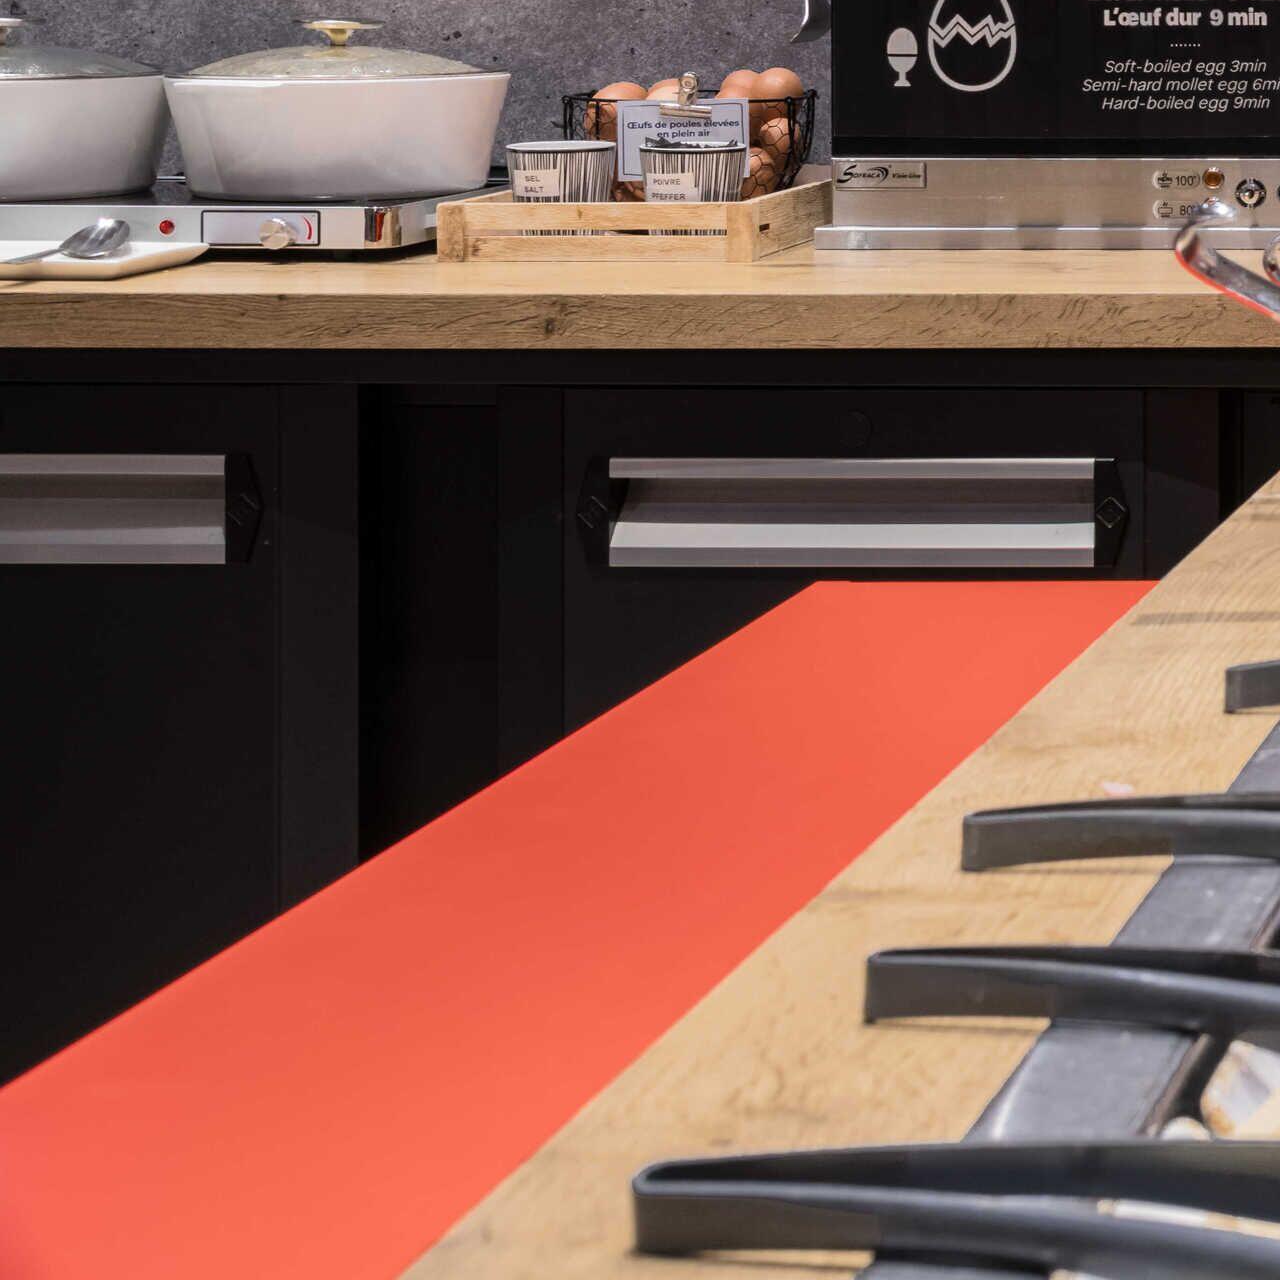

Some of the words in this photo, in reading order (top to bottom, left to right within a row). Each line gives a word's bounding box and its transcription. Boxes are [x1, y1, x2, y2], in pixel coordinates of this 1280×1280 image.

[1103, 7, 1162, 26] L'œuf
[1165, 7, 1202, 26] dur
[1209, 8, 1224, 26] 9
[1227, 7, 1268, 26] min
[1104, 59, 1193, 73] Soft-boiled
[1195, 61, 1226, 75] egg
[1230, 59, 1267, 73] 3min
[1082, 77, 1163, 92] Semi-hard
[1165, 78, 1214, 91] mollet
[1217, 80, 1249, 93] egg
[1101, 96, 1195, 110] Hard-boiled
[1198, 98, 1229, 112] egg
[1233, 96, 1271, 110] 9min
[655, 121, 667, 129] de
[669, 120, 702, 129] poules
[671, 130, 695, 139] plein
[697, 128, 710, 137] air
